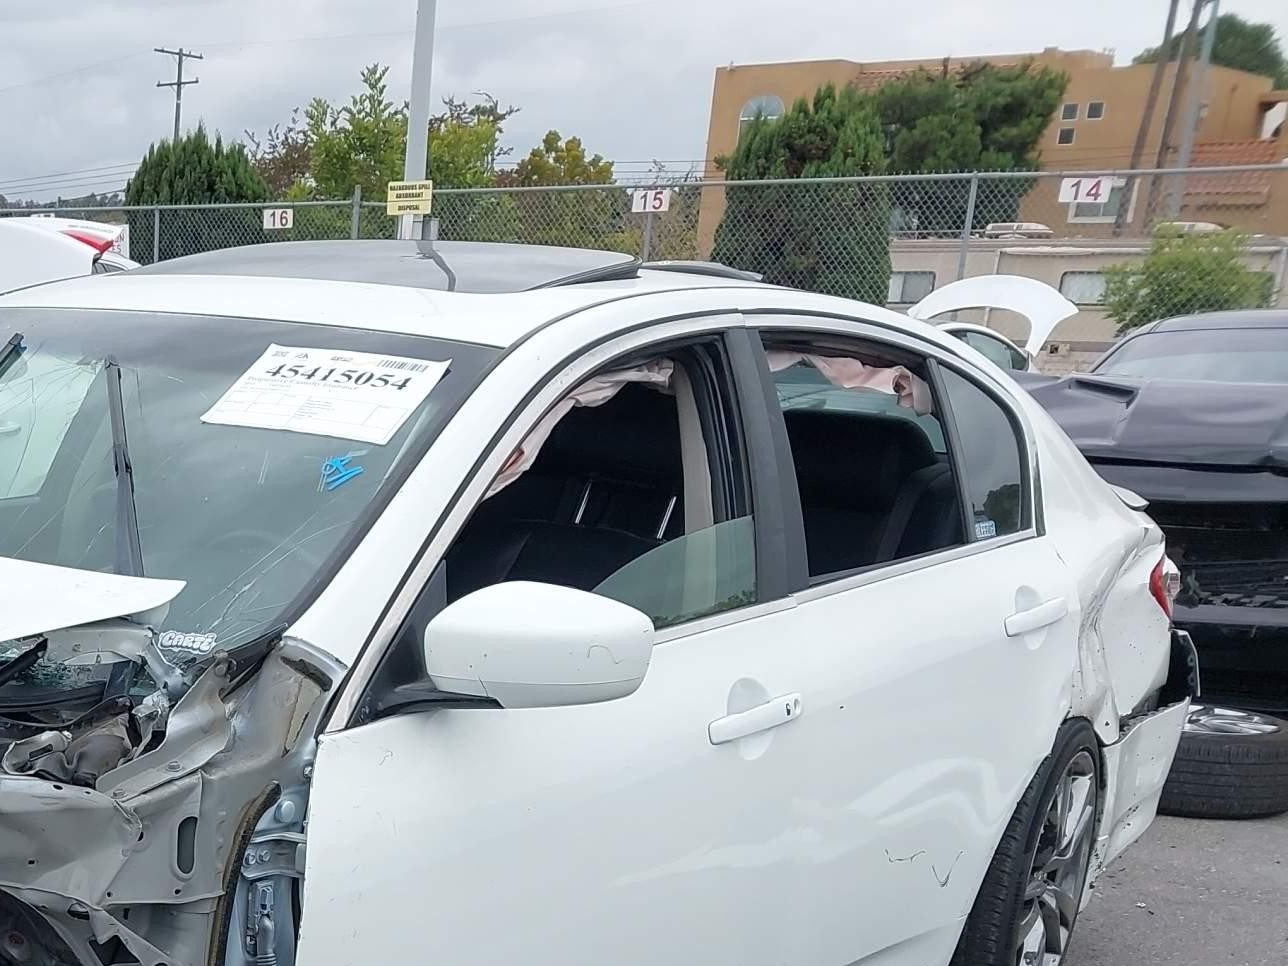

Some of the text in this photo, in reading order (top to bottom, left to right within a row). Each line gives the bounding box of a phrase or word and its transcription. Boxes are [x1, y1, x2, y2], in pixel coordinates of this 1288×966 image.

[389, 183, 417, 191] HAZARDOUS
[1070, 178, 1102, 201] 14
[639, 190, 664, 210] 15
[270, 210, 289, 227] 16
[265, 363, 413, 391] 45415054
